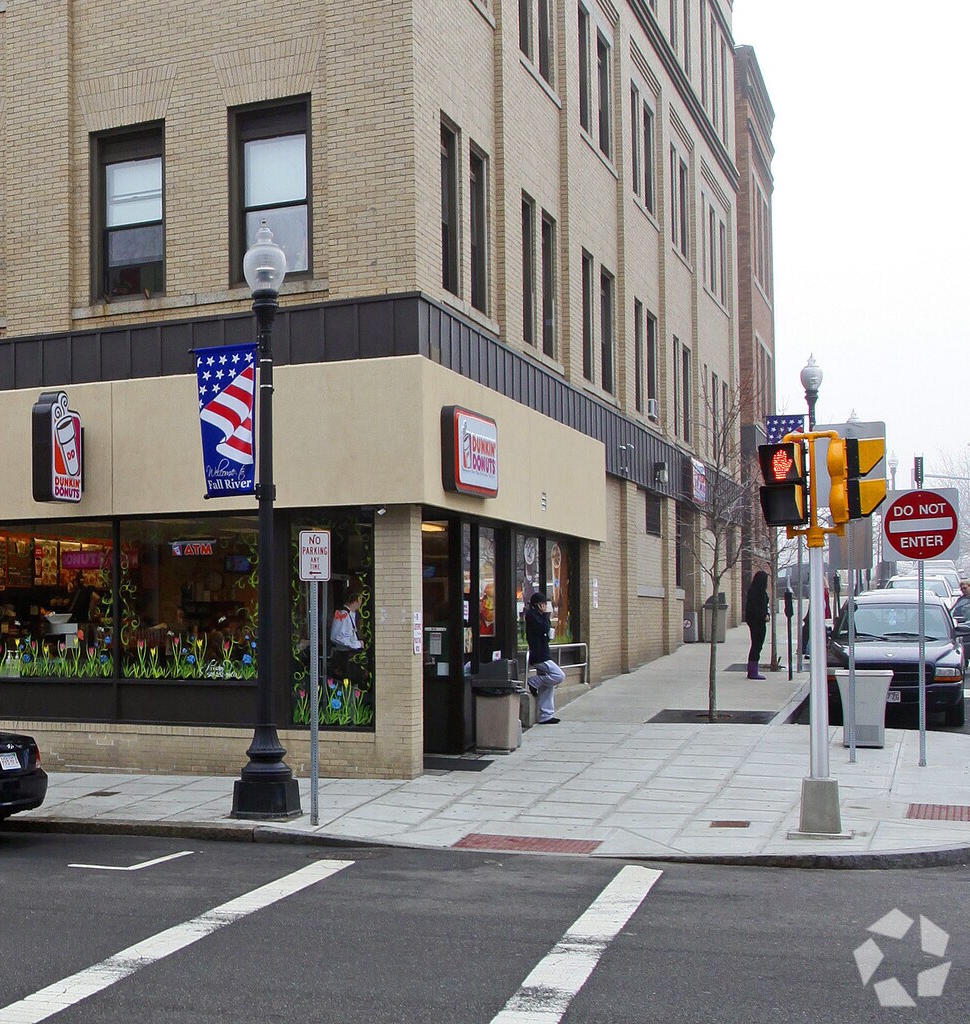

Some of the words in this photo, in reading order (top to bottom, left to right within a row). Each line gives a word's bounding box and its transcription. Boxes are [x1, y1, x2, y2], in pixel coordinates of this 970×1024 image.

[472, 434, 496, 457] DUNKIN'
[472, 453, 496, 475] DONUTS
[54, 476, 81, 489] DUNKIN'
[207, 478, 224, 490] Fall
[224, 478, 252, 489] River
[54, 485, 80, 499] DONUTS
[893, 505, 914, 517] DO
[919, 503, 946, 515] NOT
[309, 536, 321, 545] NO
[900, 535, 943, 548] ENTER
[184, 543, 213, 556] ATM
[302, 547, 328, 556] PARKING
